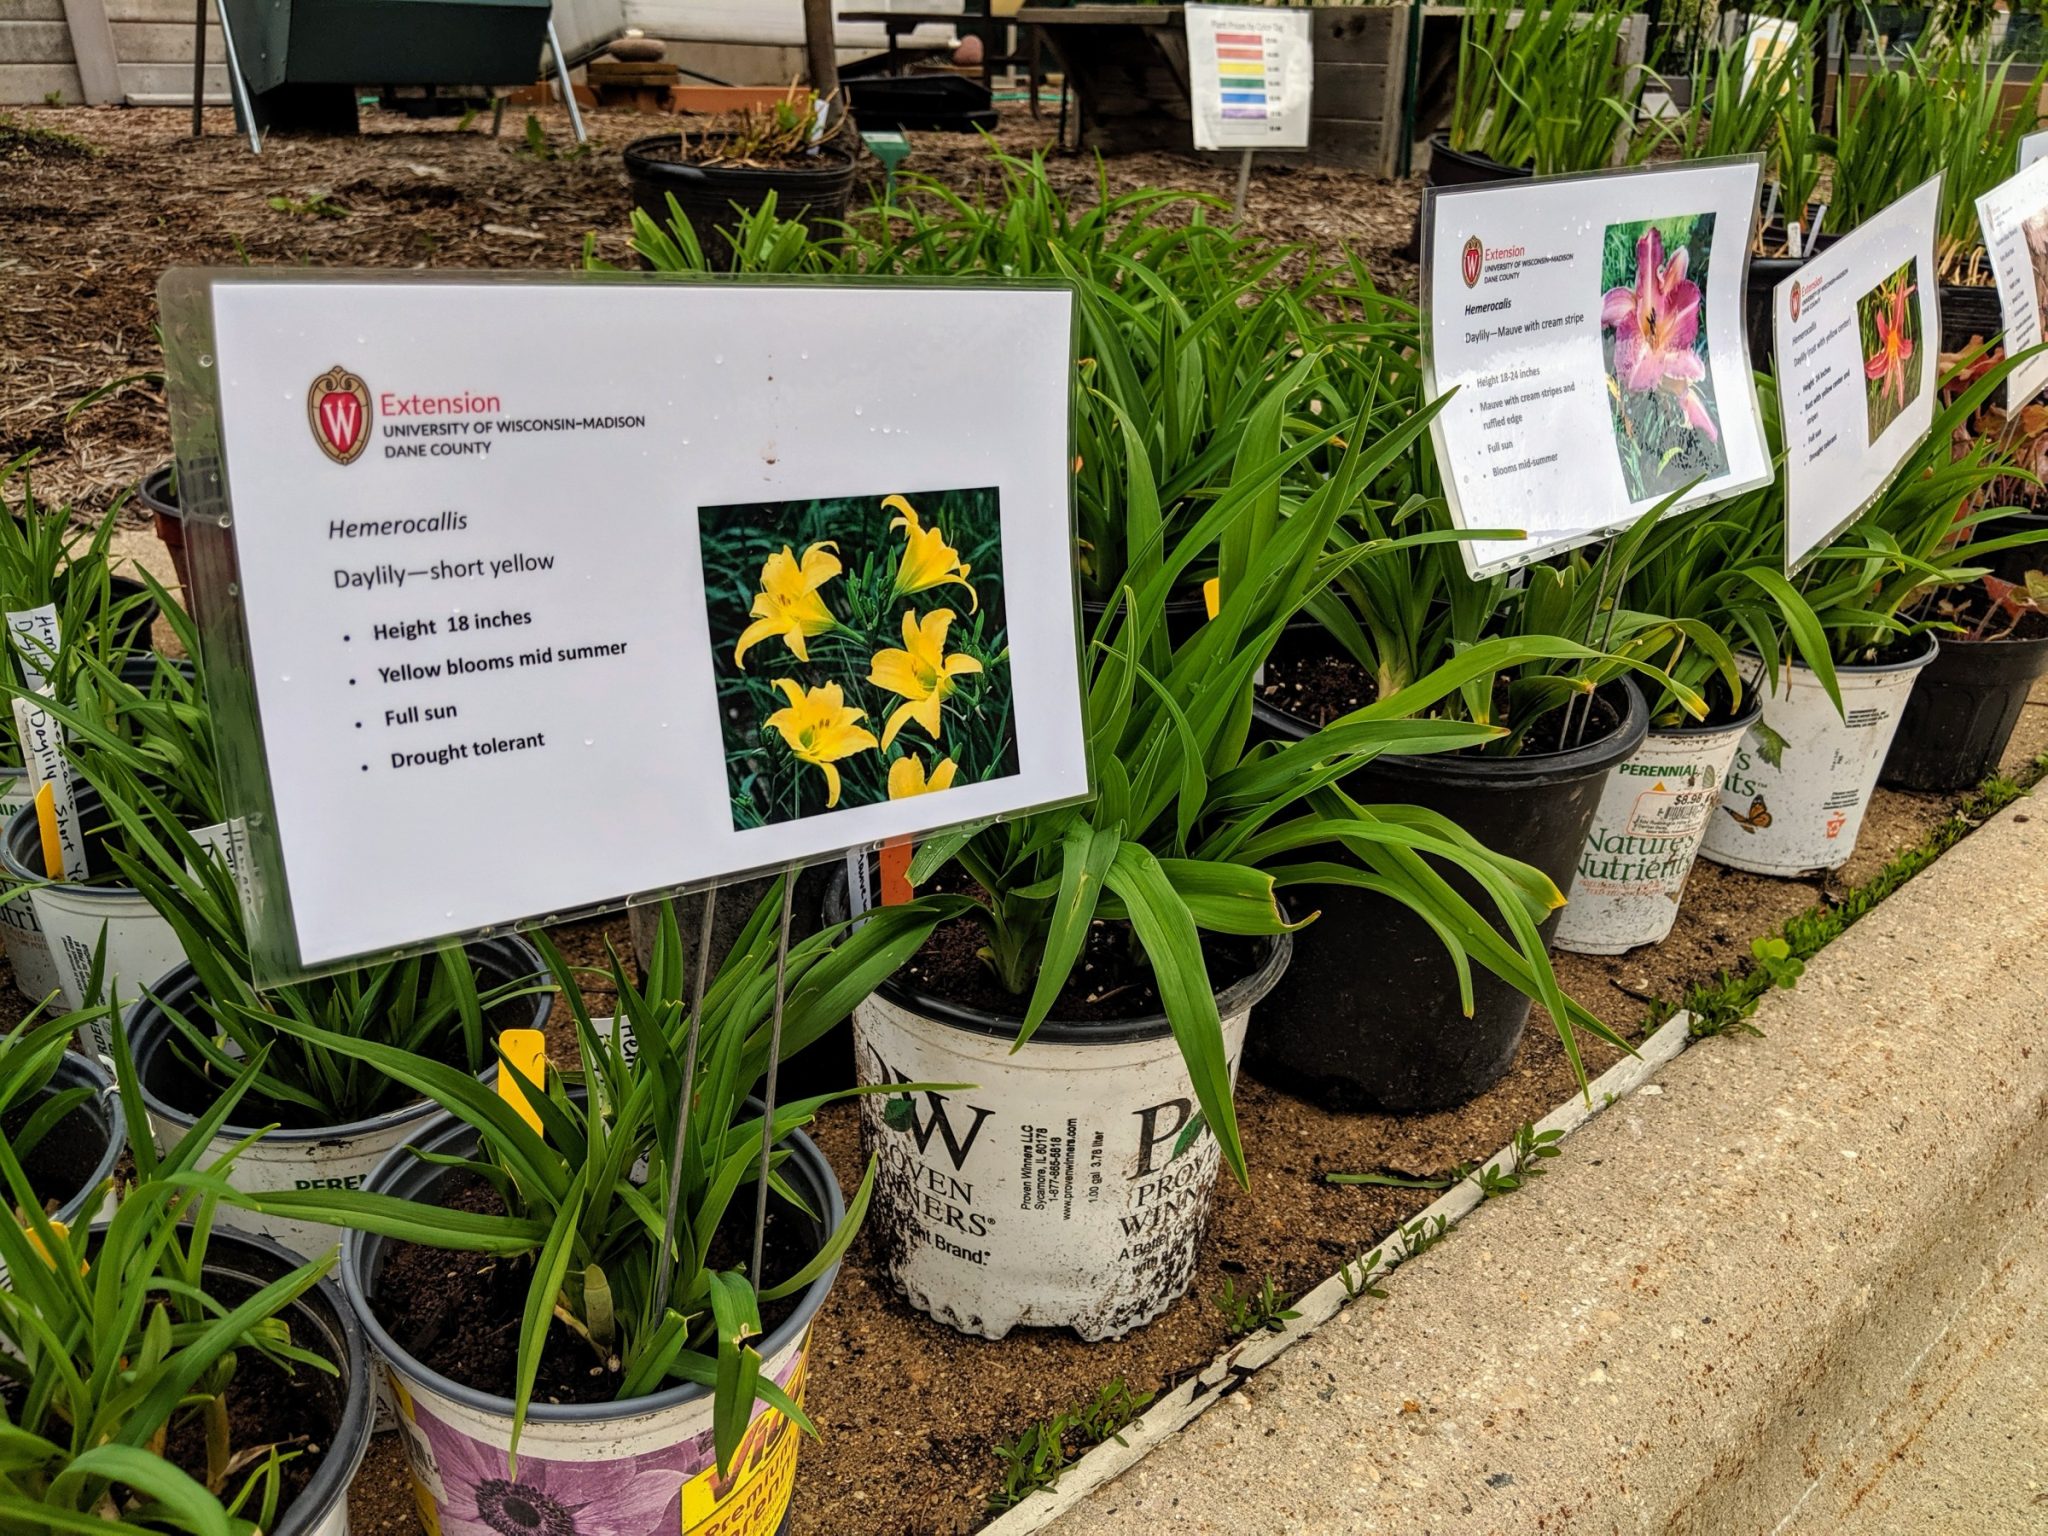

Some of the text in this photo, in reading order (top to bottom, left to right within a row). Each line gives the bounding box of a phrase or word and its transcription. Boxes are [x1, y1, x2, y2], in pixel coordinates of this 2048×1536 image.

[1485, 245, 1525, 261] Extension
[1484, 272, 1520, 284] DANE COUNTY
[1485, 261, 1513, 273] UNIVERSITY
[1514, 260, 1521, 268] OF
[1524, 319, 1540, 333] with
[1541, 317, 1563, 329] cream
[1565, 313, 1584, 327] stripe
[1476, 367, 1540, 388] Height 18-24 inches
[380, 391, 500, 417] Extension
[1480, 381, 1575, 412] Mauve with cream stripes and
[323, 402, 357, 446] W
[383, 421, 469, 438] UNIVERSITY
[473, 420, 494, 435] OF
[1483, 413, 1523, 431] ruffled edge
[384, 441, 492, 459] DANE COUNTY
[1487, 440, 1513, 454] Full sun
[1492, 452, 1558, 477] Blooms mid-summer
[328, 511, 468, 540] Hemerocallis
[489, 553, 555, 579] yellow
[373, 609, 532, 642] Height 18 inches
[378, 640, 628, 684] Yellow blooms mid summer
[385, 704, 458, 728] Full sun
[31, 707, 58, 782] Daylily
[391, 731, 546, 769] Drought tolerant
[1619, 763, 1698, 777] PERENNIAL
[1020, 1124, 1034, 1211] Proven Winners LLC
[1034, 1128, 1048, 1211] Sycamore, IL 60178
[1063, 1118, 1077, 1221] www.provenwinners.com
[1088, 1131, 1104, 1203] 1.00 gal 3.78 liter
